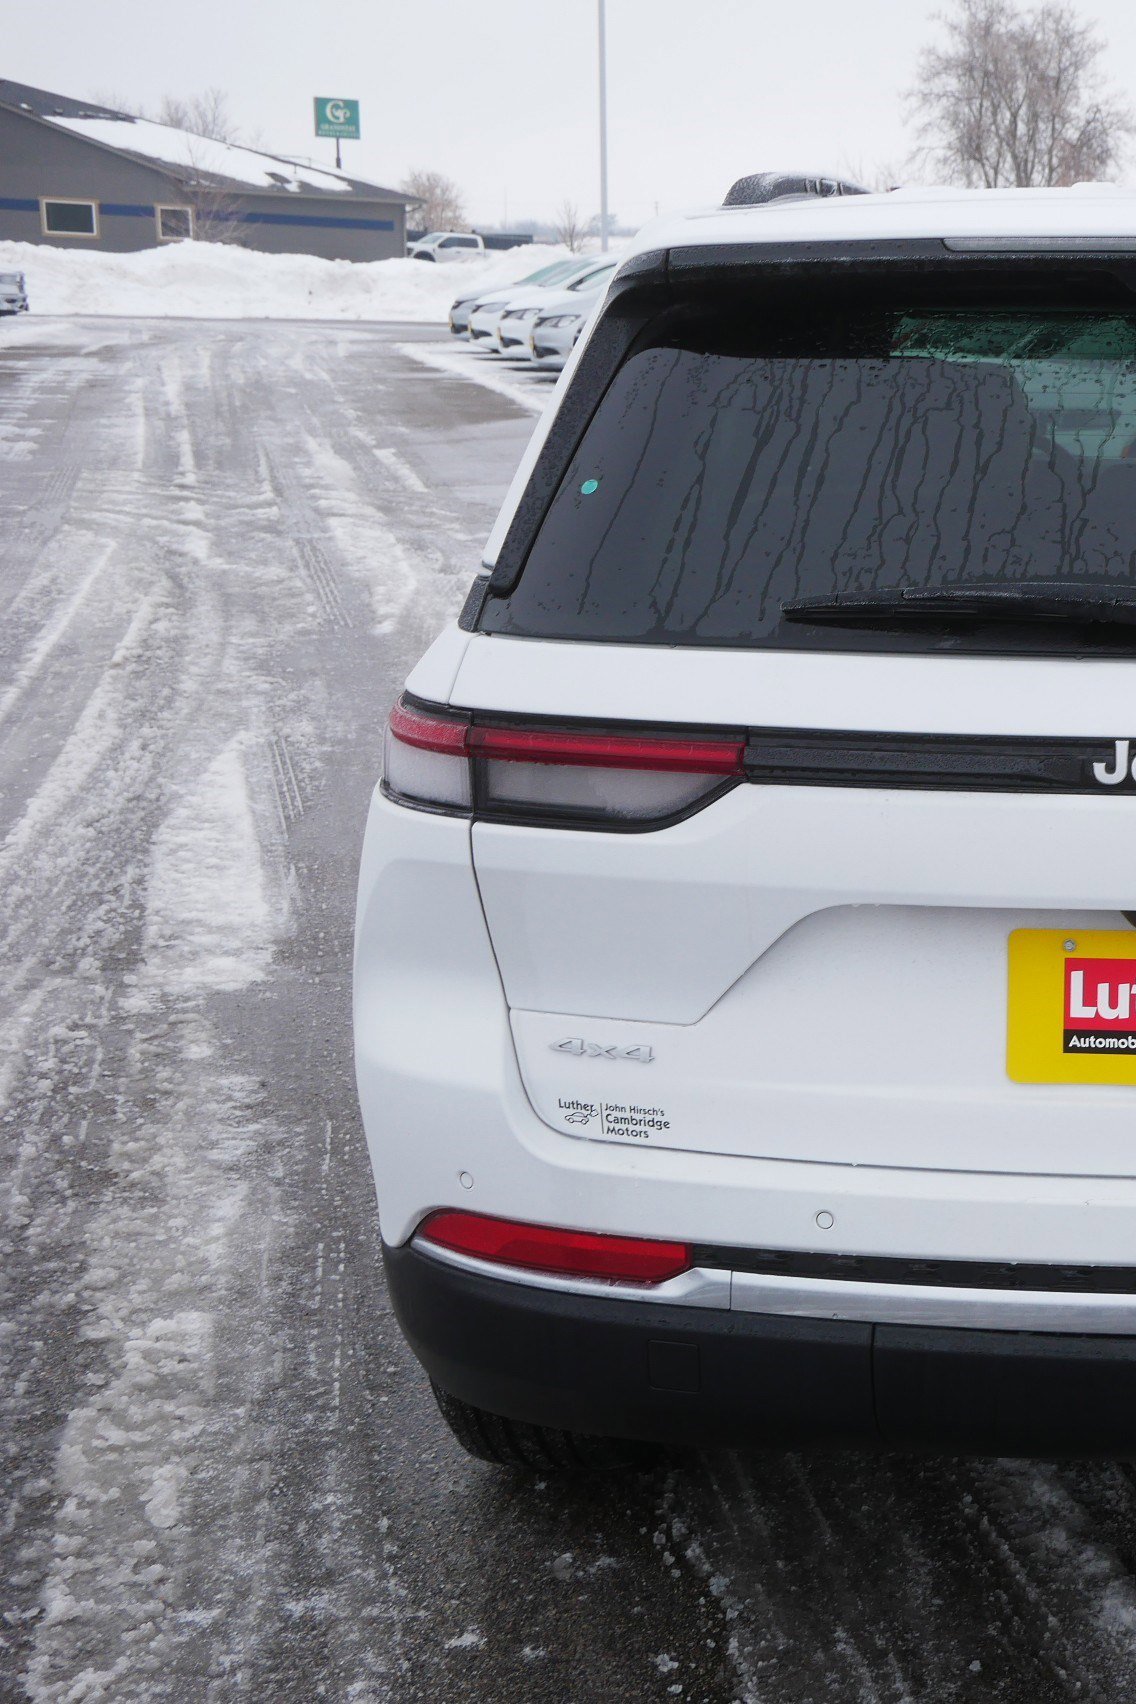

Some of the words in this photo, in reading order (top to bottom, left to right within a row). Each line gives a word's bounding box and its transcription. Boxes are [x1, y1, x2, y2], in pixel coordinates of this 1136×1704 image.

[558, 1098, 595, 1112] Luther
[604, 1103, 627, 1114] John
[629, 1106, 666, 1117] Hirsch's
[605, 1113, 671, 1130] Cambridge
[606, 1126, 650, 1139] Motors
